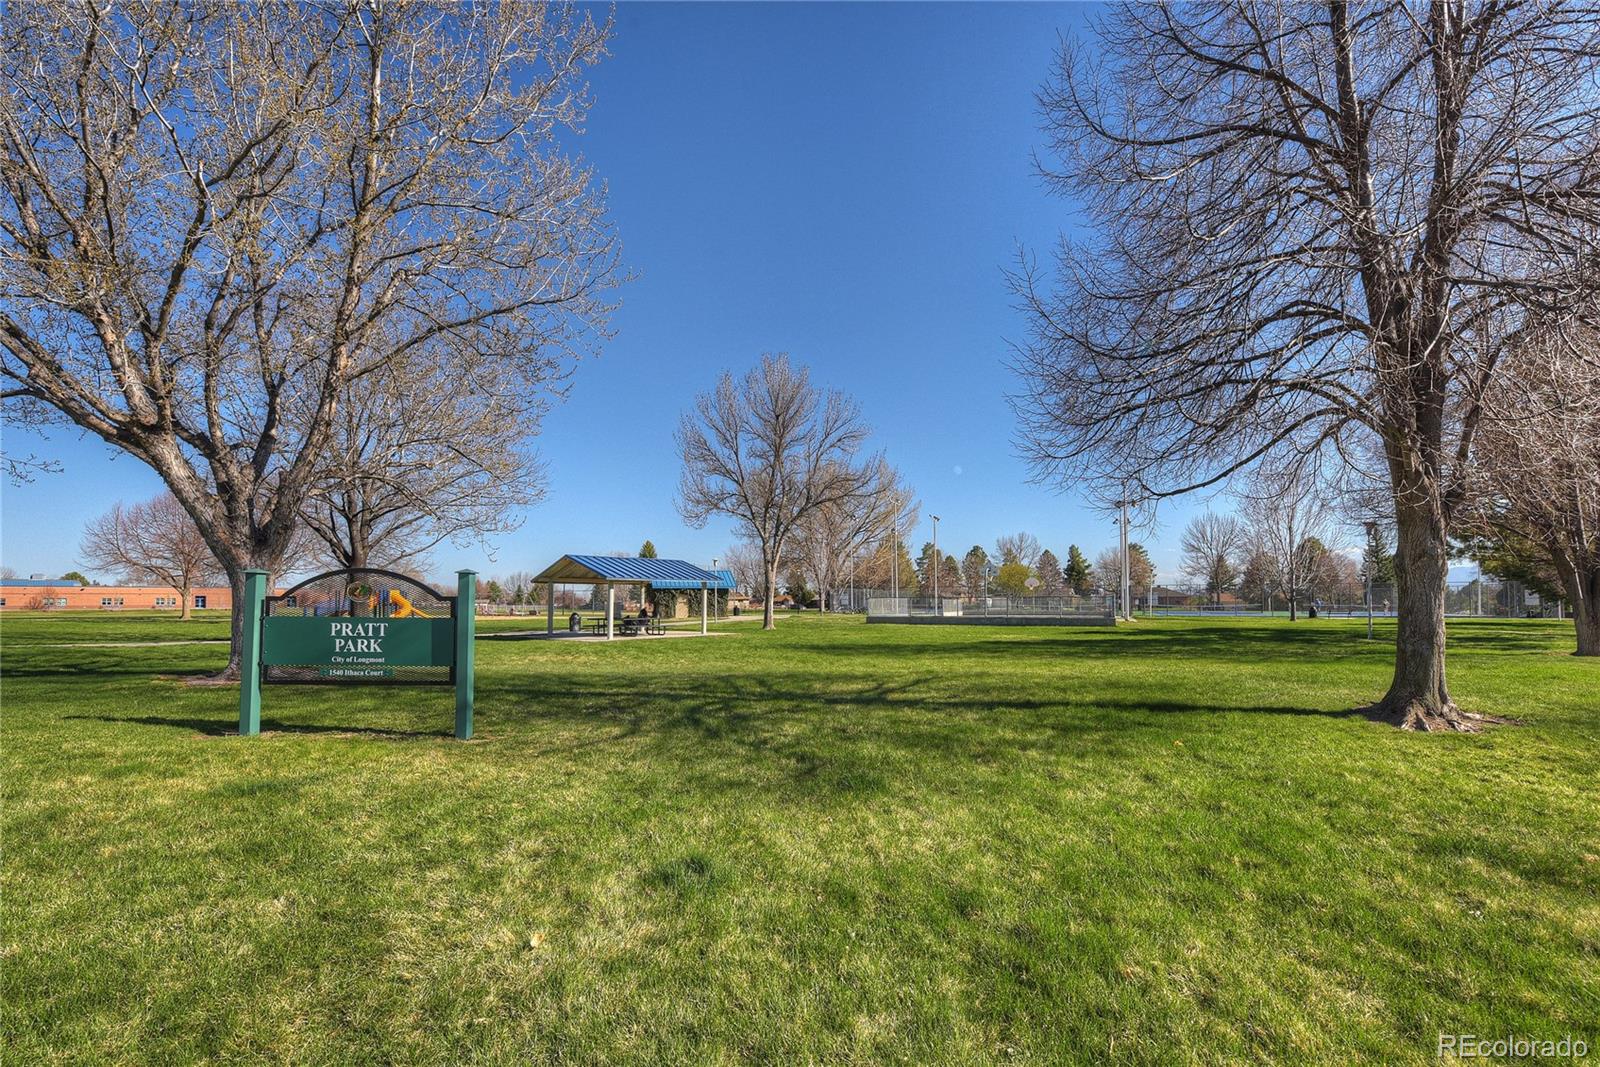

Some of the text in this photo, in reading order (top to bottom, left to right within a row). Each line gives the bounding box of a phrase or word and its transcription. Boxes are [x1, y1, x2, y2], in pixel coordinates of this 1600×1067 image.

[330, 622, 388, 637] PRATT
[334, 639, 383, 652] PARK
[331, 656, 345, 664] City
[353, 656, 385, 664] Longmont
